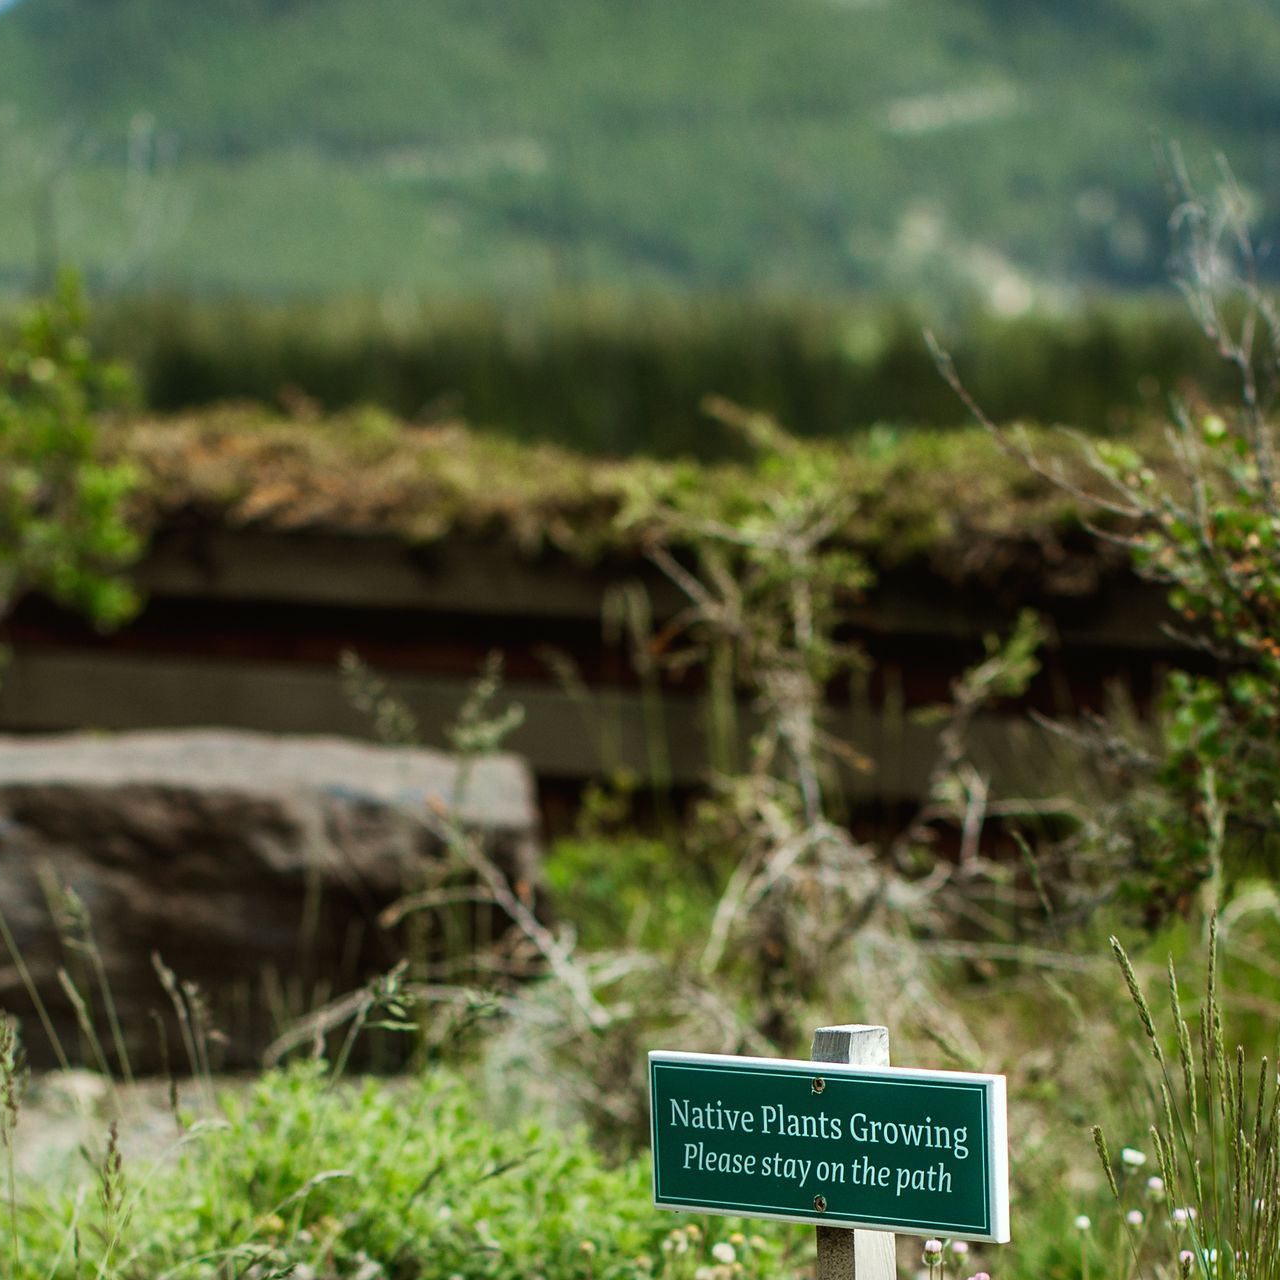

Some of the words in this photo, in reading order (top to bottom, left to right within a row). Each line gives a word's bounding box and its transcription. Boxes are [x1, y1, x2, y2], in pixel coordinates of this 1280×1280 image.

[669, 1098, 754, 1133] Native
[761, 1103, 842, 1140] Plants
[850, 1112, 969, 1159] Growing
[683, 1143, 756, 1174] Please
[761, 1152, 811, 1187] stay
[816, 1161, 846, 1184] on
[851, 1156, 890, 1187] the
[896, 1163, 952, 1196] path
